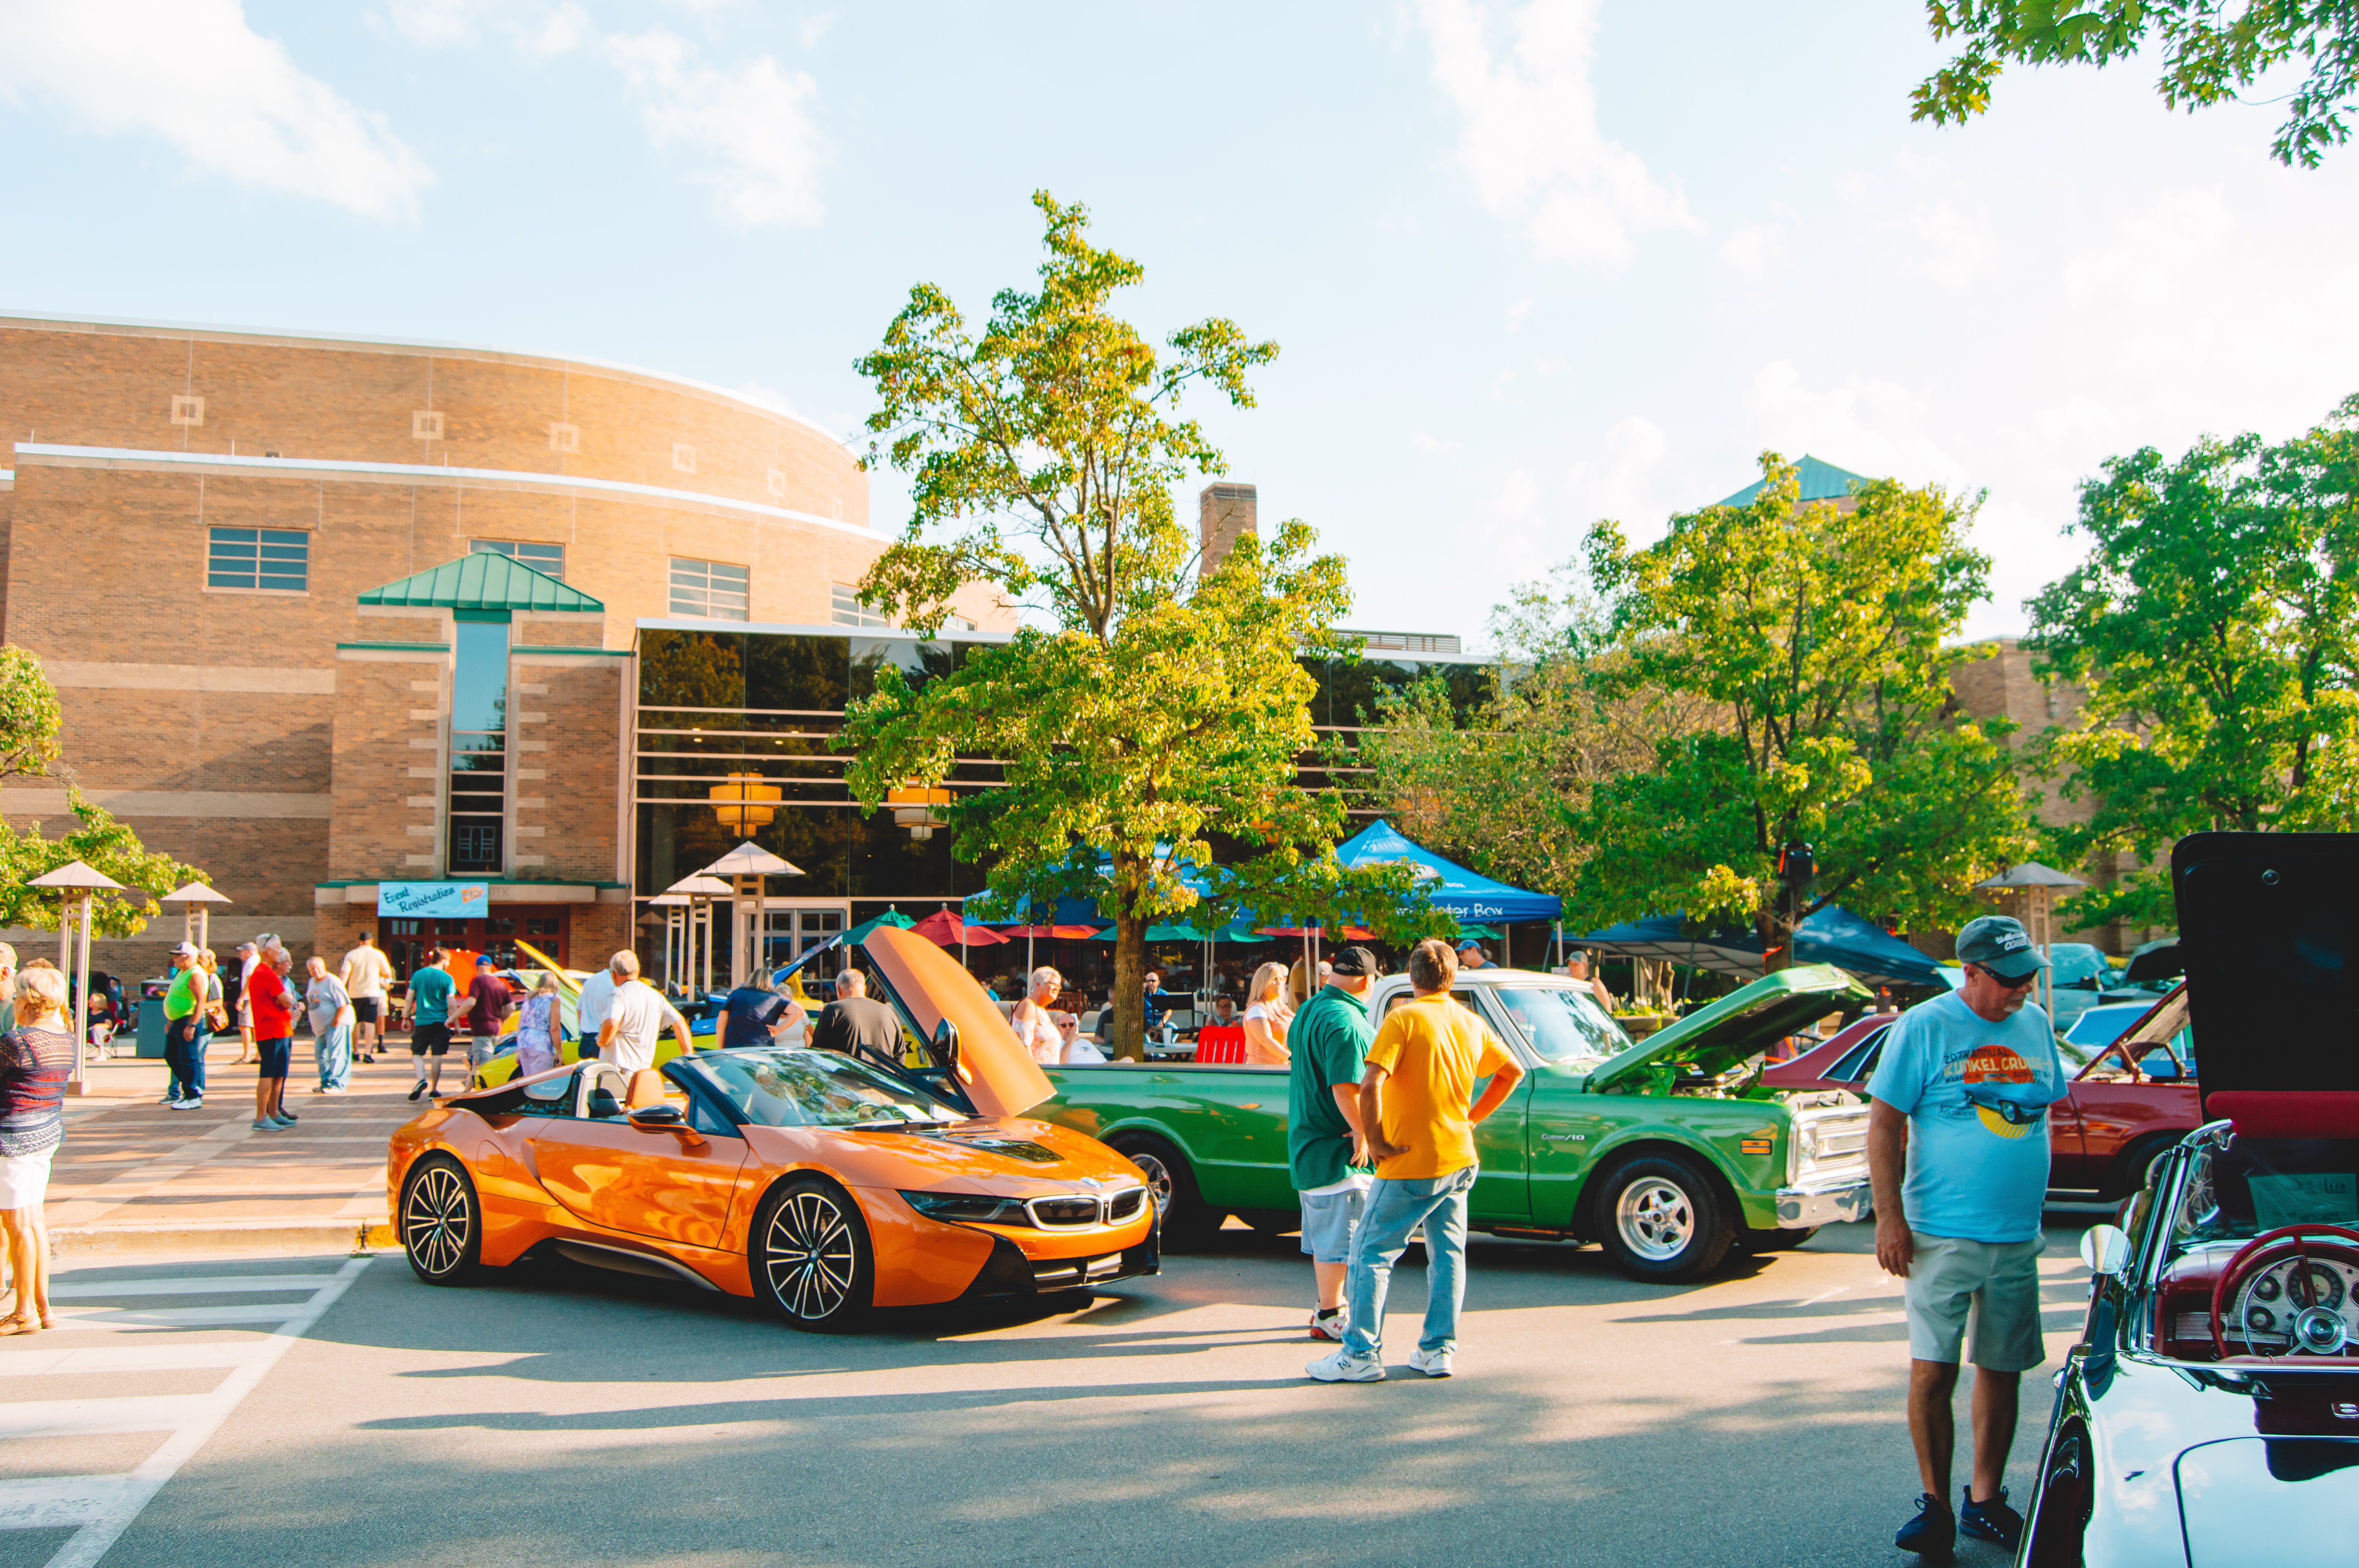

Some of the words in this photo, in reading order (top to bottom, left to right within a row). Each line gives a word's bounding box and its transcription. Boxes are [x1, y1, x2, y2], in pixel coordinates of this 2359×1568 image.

[383, 886, 410, 904] Event
[398, 887, 456, 913] Registration
[1474, 903, 1503, 917] Box
